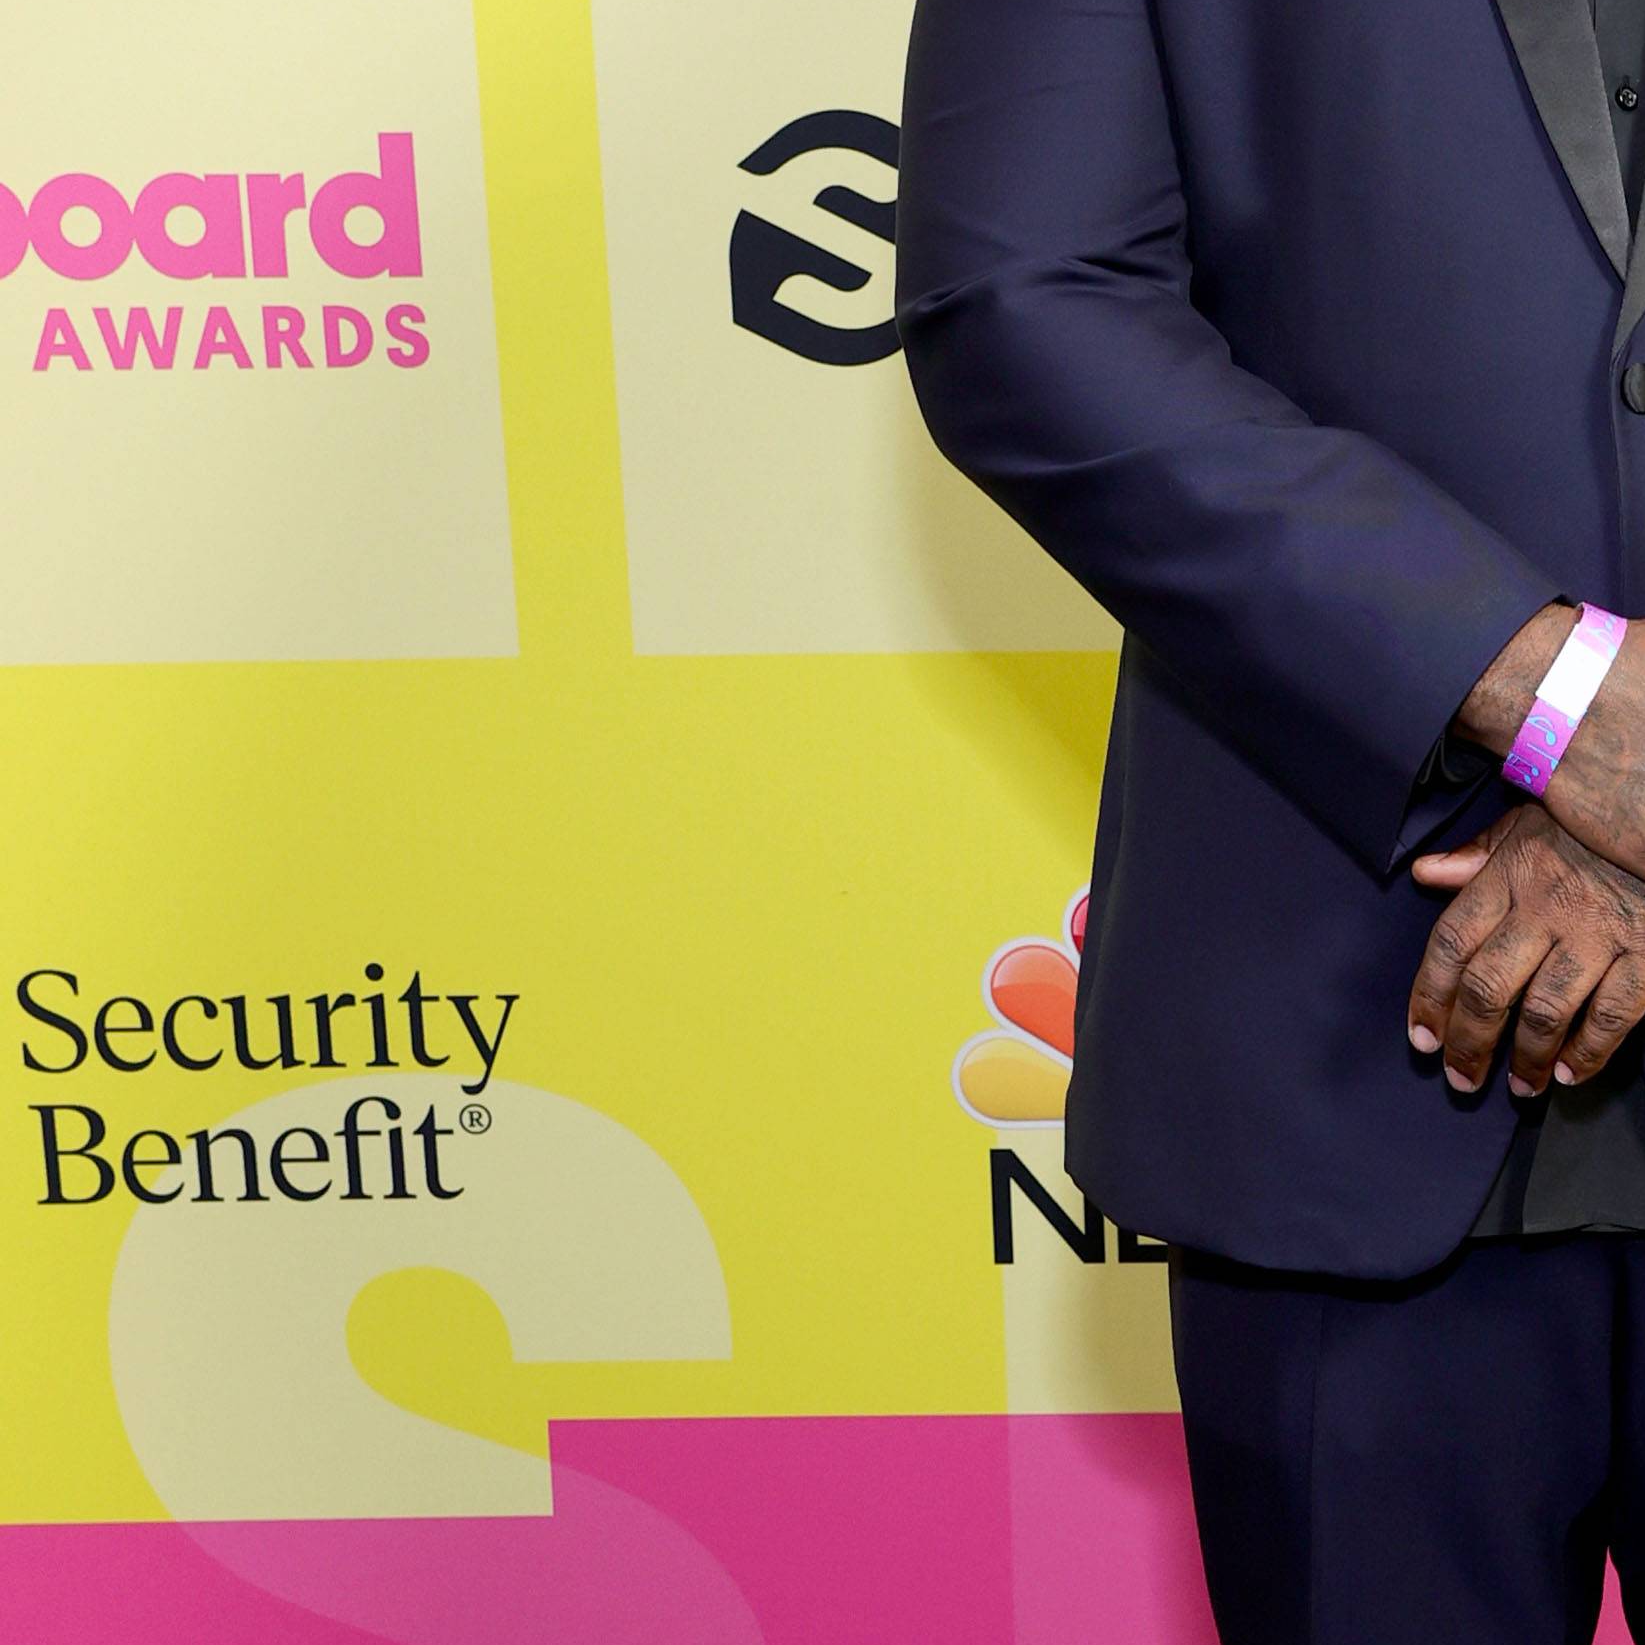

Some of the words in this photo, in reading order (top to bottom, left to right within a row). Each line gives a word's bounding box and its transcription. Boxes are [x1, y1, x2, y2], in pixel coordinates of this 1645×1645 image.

[0, 133, 423, 281] oard
[34, 305, 430, 372] AWARDS
[18, 964, 520, 1095] Security
[30, 1097, 493, 1205] Benefit®
